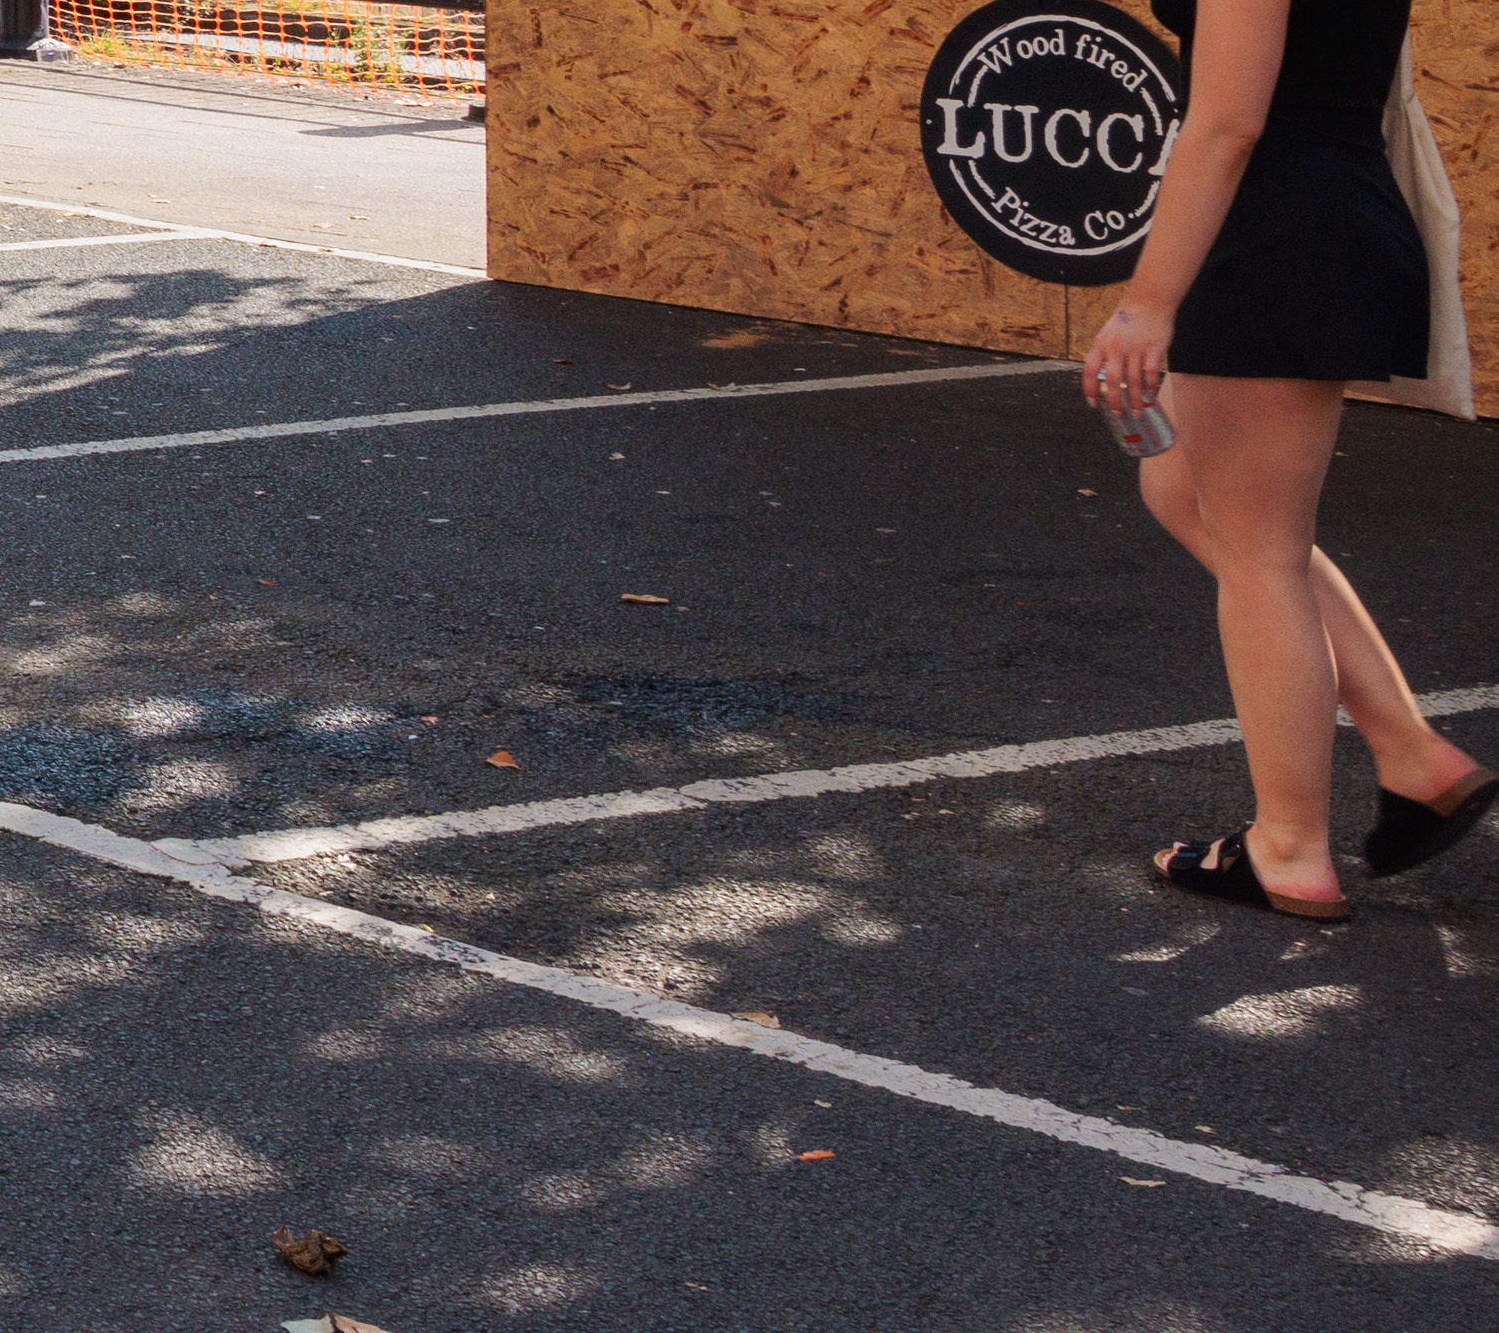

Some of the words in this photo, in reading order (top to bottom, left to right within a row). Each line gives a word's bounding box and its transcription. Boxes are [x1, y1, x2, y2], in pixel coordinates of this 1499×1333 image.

[977, 29, 1066, 74] Wood
[1074, 34, 1148, 92] fired
[991, 187, 1075, 246] Pizza
[1084, 210, 1135, 241] Co.
